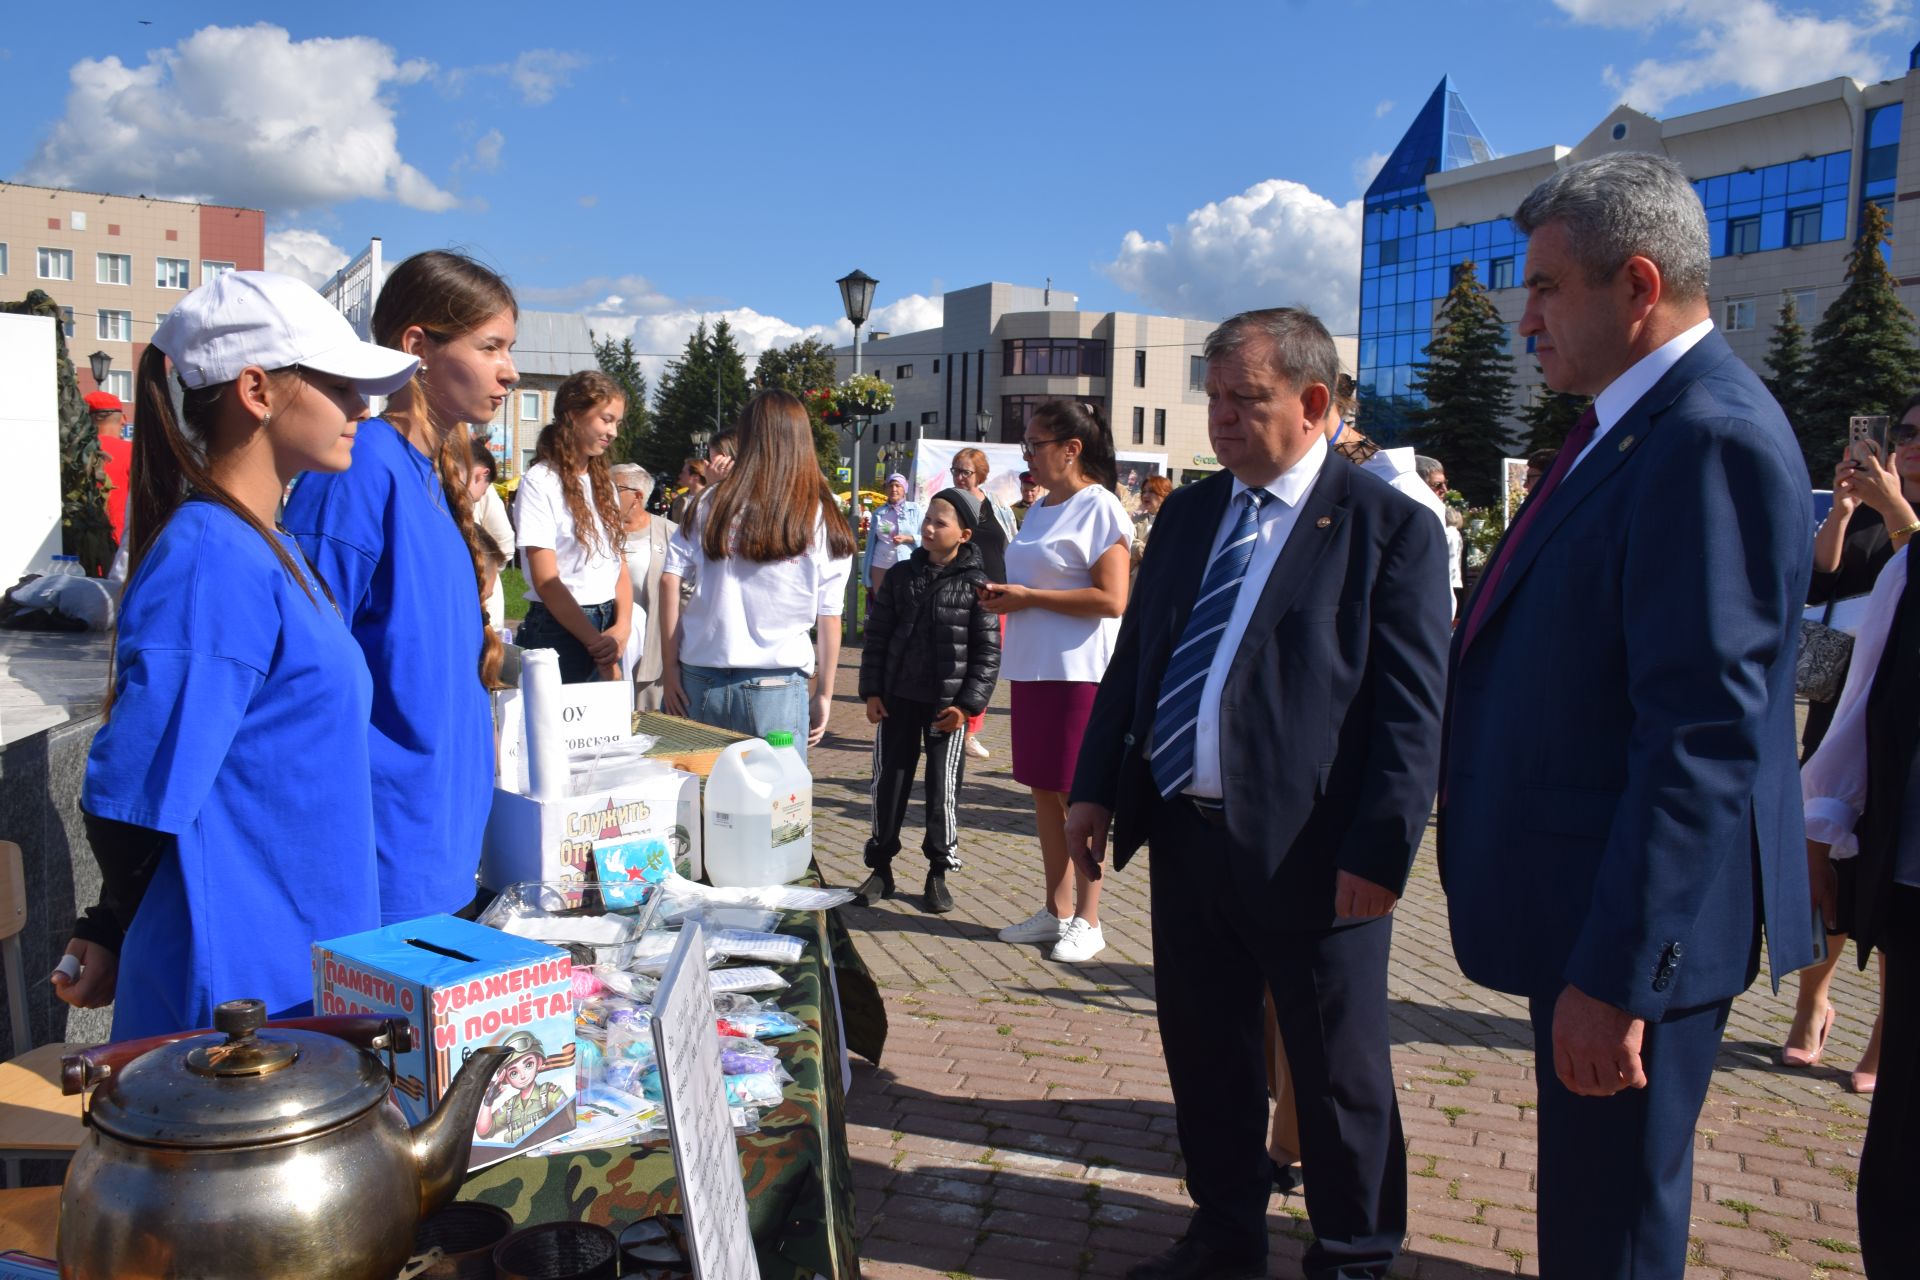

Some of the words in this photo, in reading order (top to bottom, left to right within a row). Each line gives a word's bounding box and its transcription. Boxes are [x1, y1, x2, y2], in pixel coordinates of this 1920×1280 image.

[562, 705, 588, 723] ОУ
[325, 960, 396, 1007] ПАМЯТИ
[400, 988, 414, 1013] О
[432, 957, 572, 1015] УВАЖЕНИЯ
[435, 1023, 457, 1050] И
[464, 990, 573, 1042] ПОЧЁТА!
